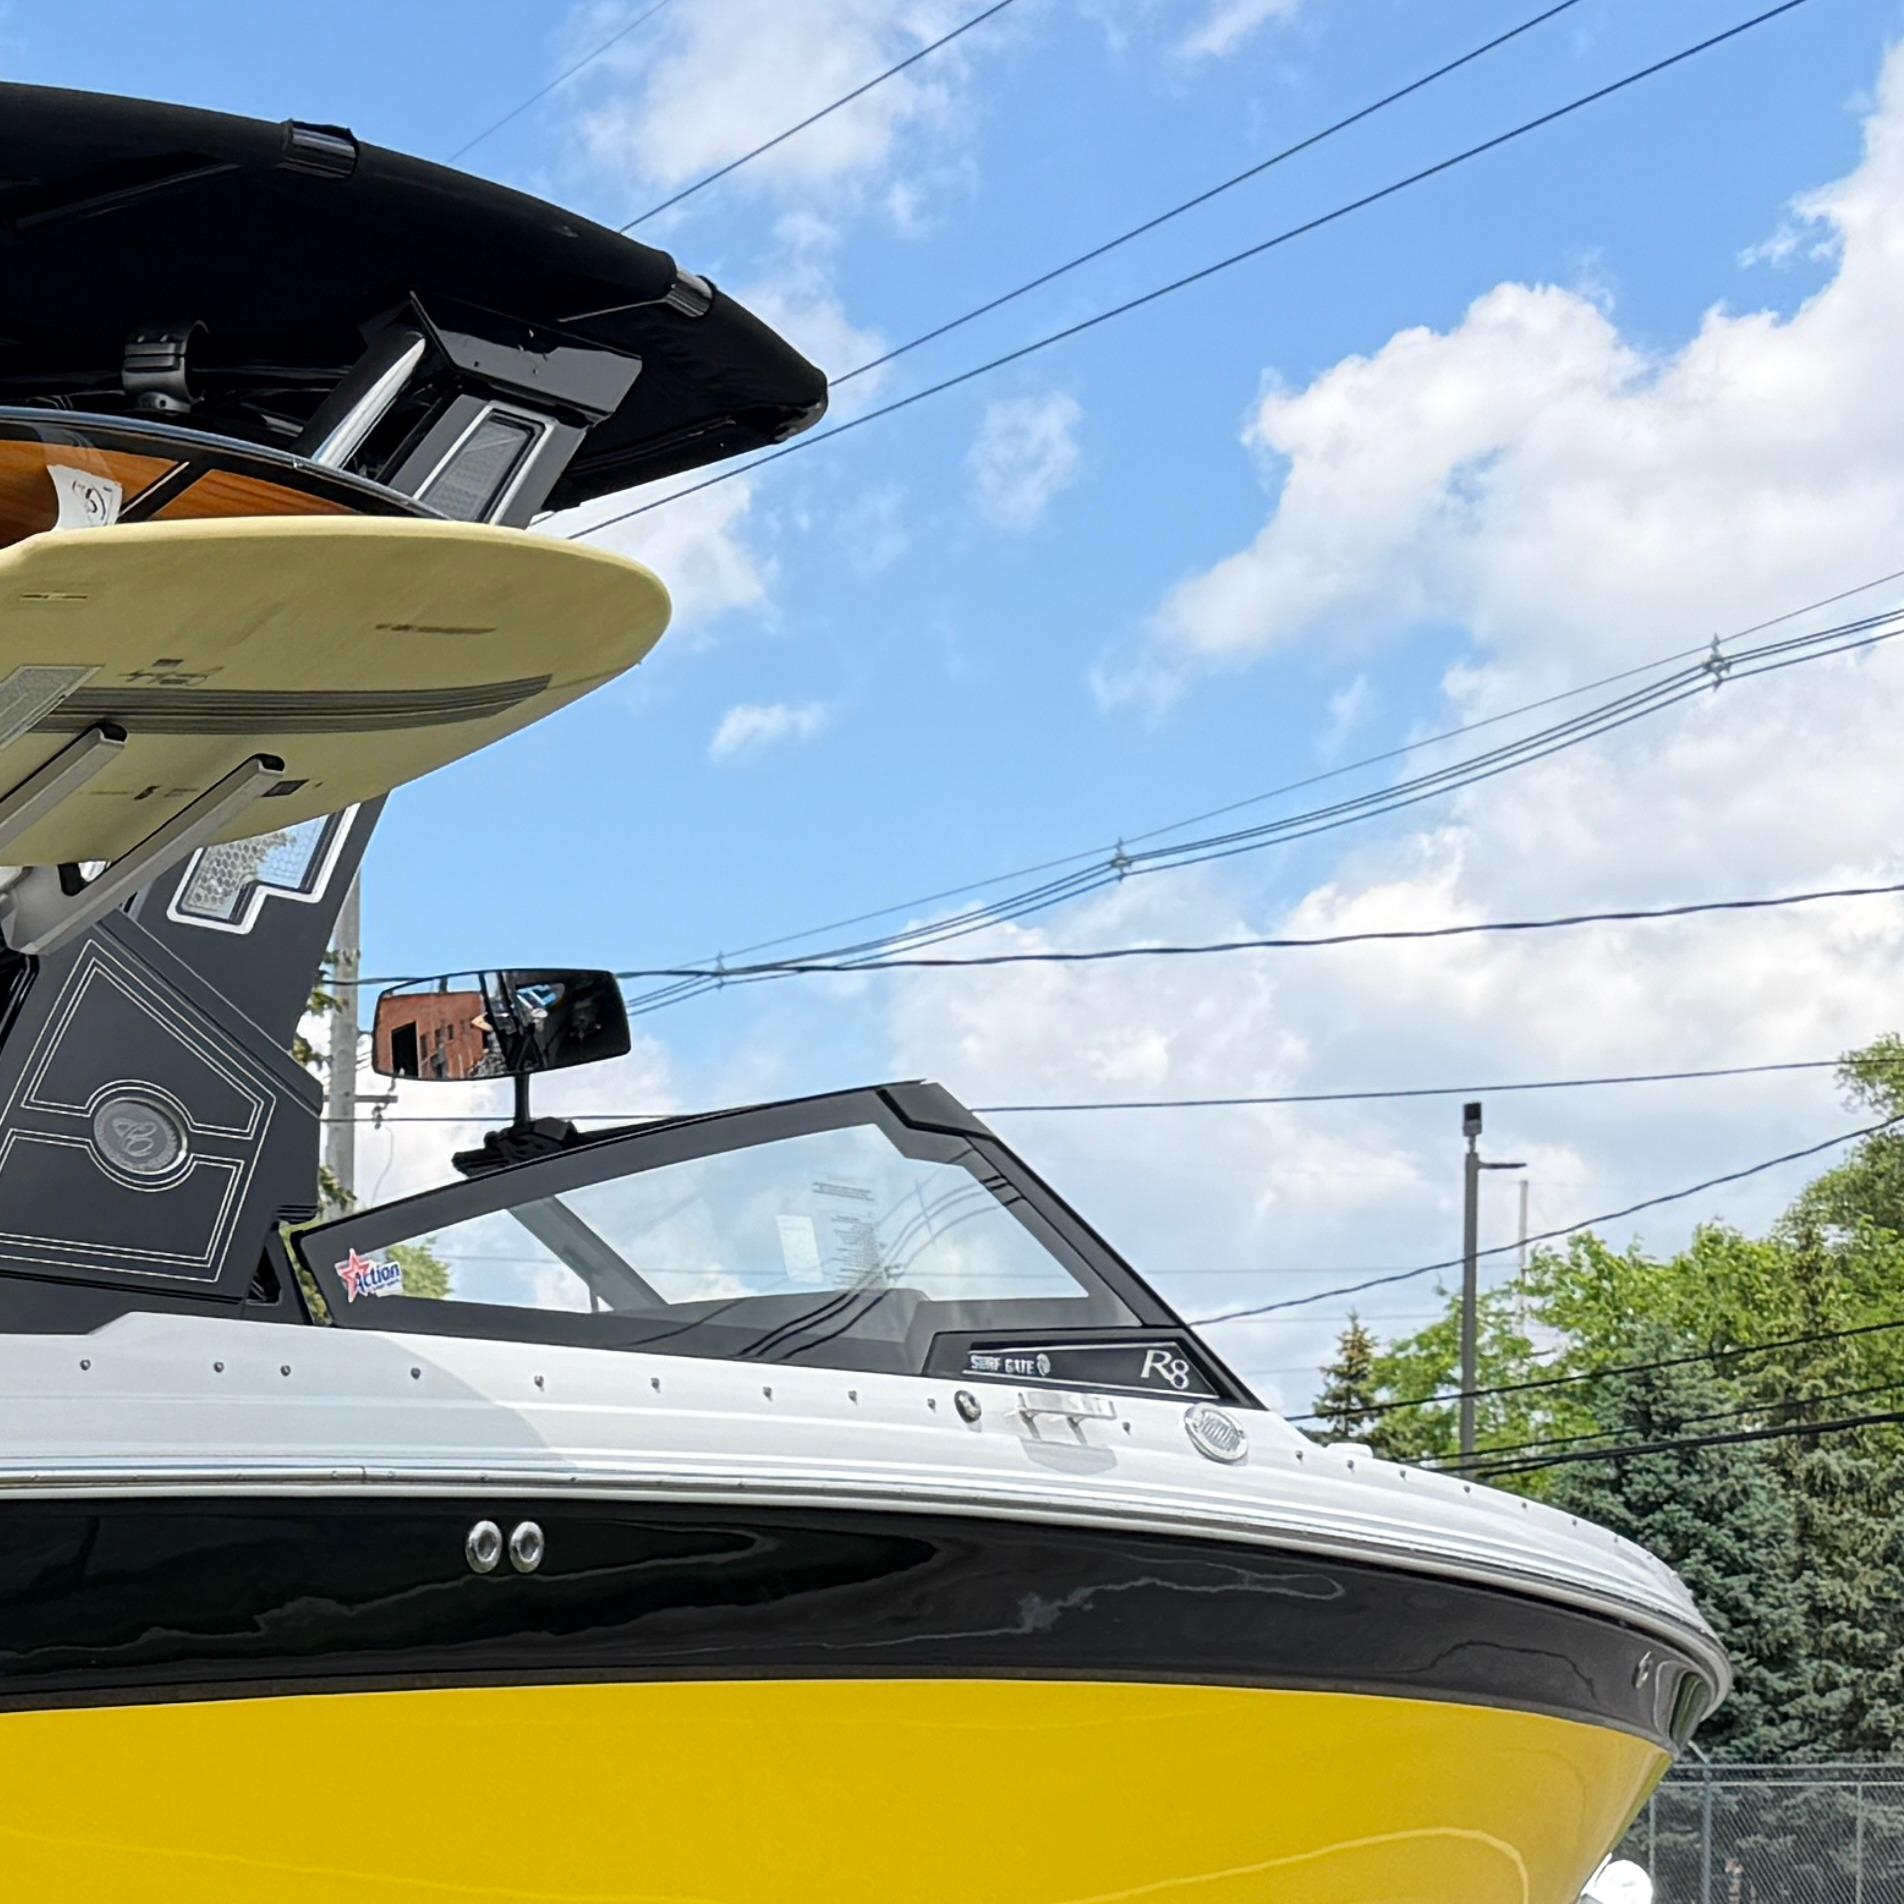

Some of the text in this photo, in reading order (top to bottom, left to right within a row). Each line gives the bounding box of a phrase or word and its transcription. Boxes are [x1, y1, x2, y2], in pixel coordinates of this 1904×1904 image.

[970, 1354, 1036, 1374] SURF GATE
[1140, 1349, 1190, 1390] R8
